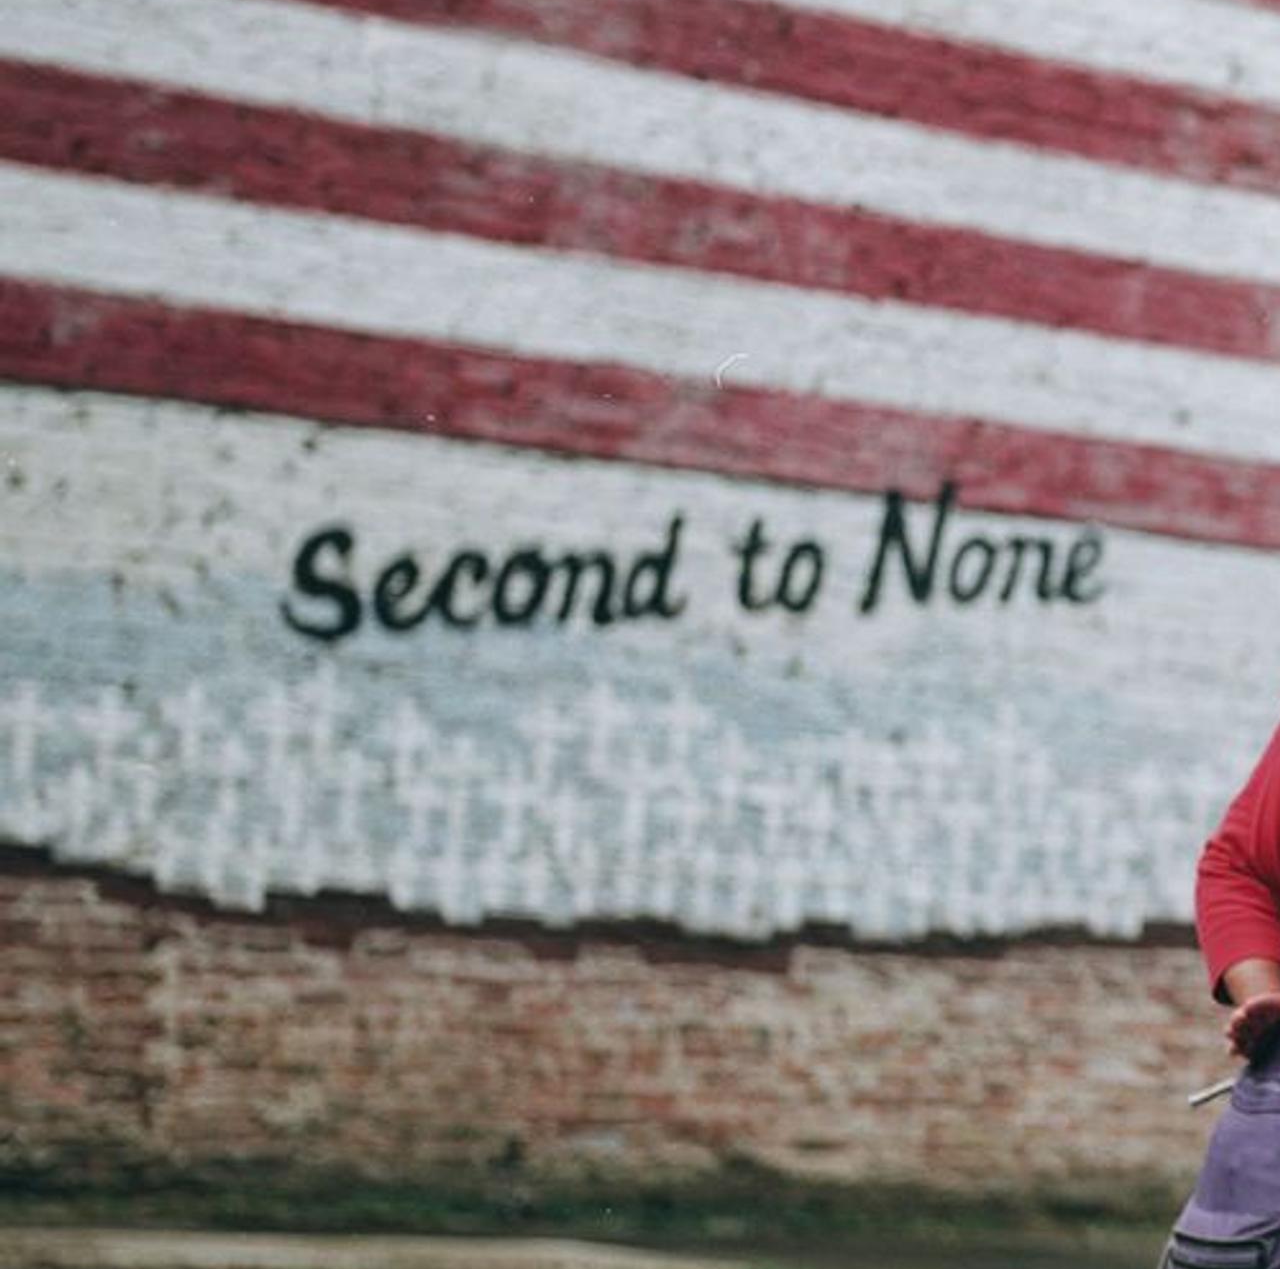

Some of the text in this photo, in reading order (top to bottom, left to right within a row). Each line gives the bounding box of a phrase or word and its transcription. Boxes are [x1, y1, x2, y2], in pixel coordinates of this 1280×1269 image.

[281, 480, 1107, 644] Second to None
